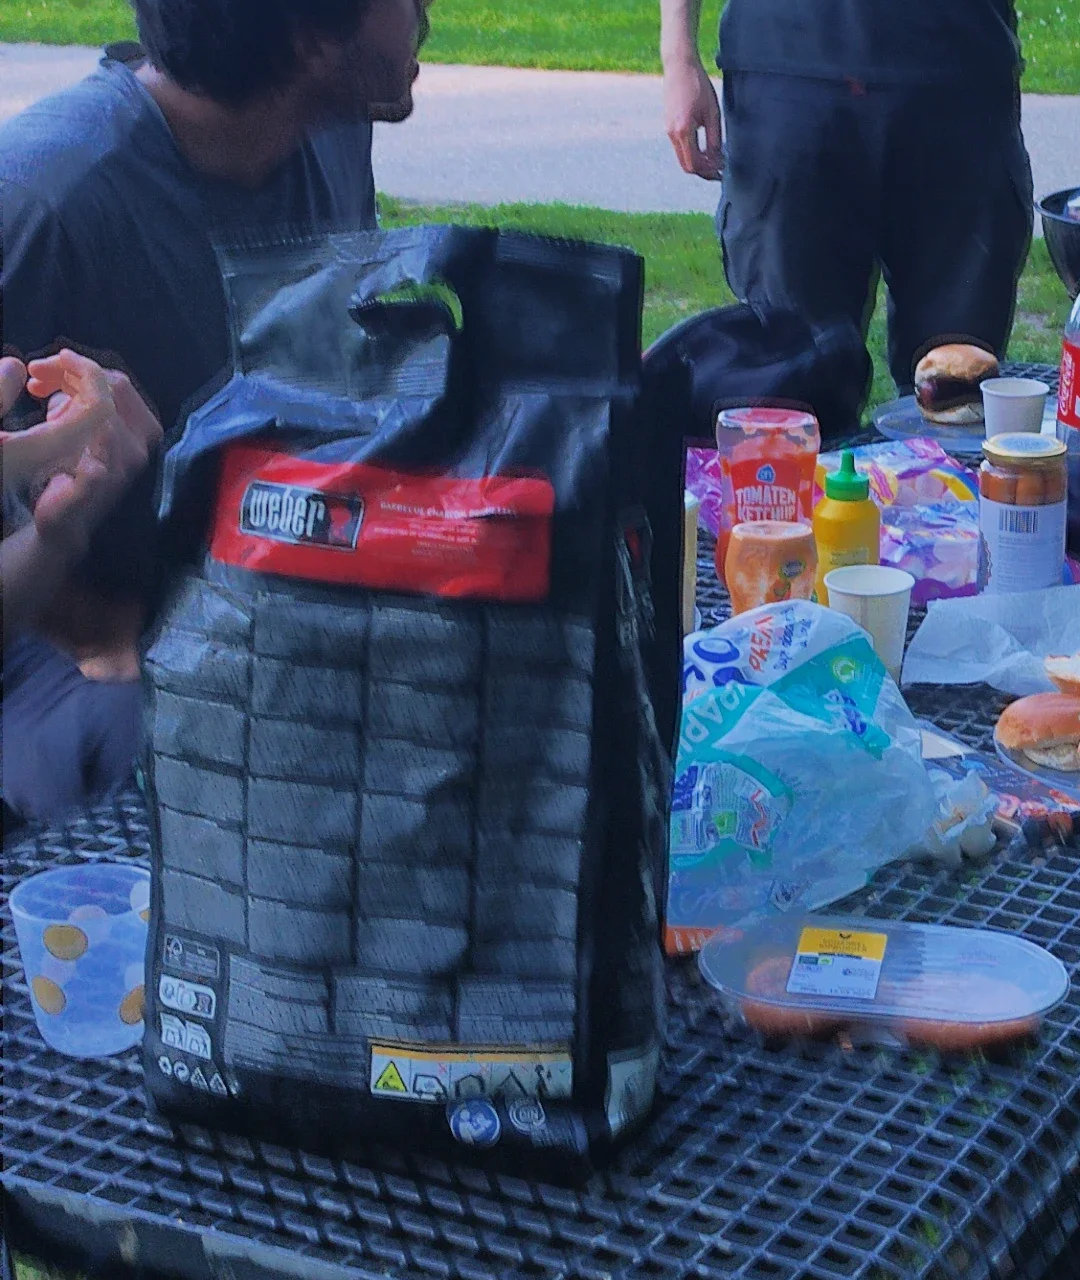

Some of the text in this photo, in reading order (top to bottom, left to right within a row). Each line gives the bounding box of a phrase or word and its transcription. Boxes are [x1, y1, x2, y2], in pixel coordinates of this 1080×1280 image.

[735, 485, 796, 506] TOMATEN
[249, 486, 325, 537] weber
[737, 504, 796, 522] KETCHUP
